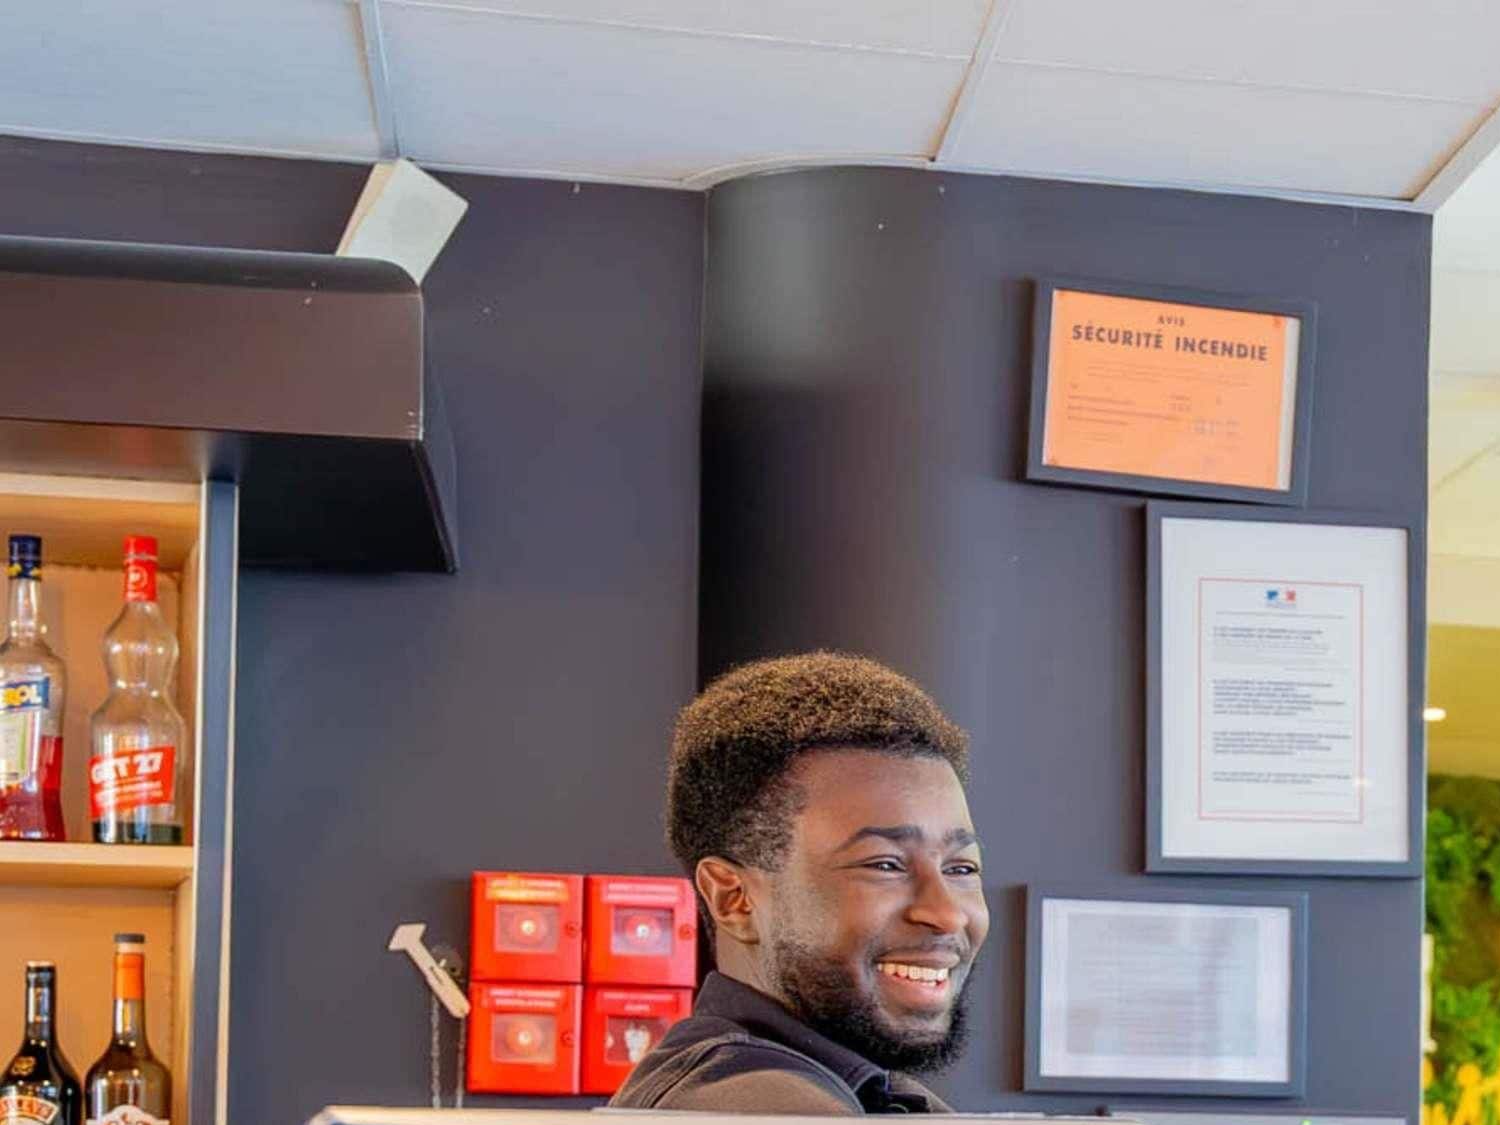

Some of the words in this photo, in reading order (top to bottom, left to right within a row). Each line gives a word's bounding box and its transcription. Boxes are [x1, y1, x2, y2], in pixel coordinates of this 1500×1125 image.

[1157, 315, 1185, 327] AVIS
[1072, 320, 1163, 350] SÉCURITÉ
[1175, 337, 1268, 361] INCENDIE
